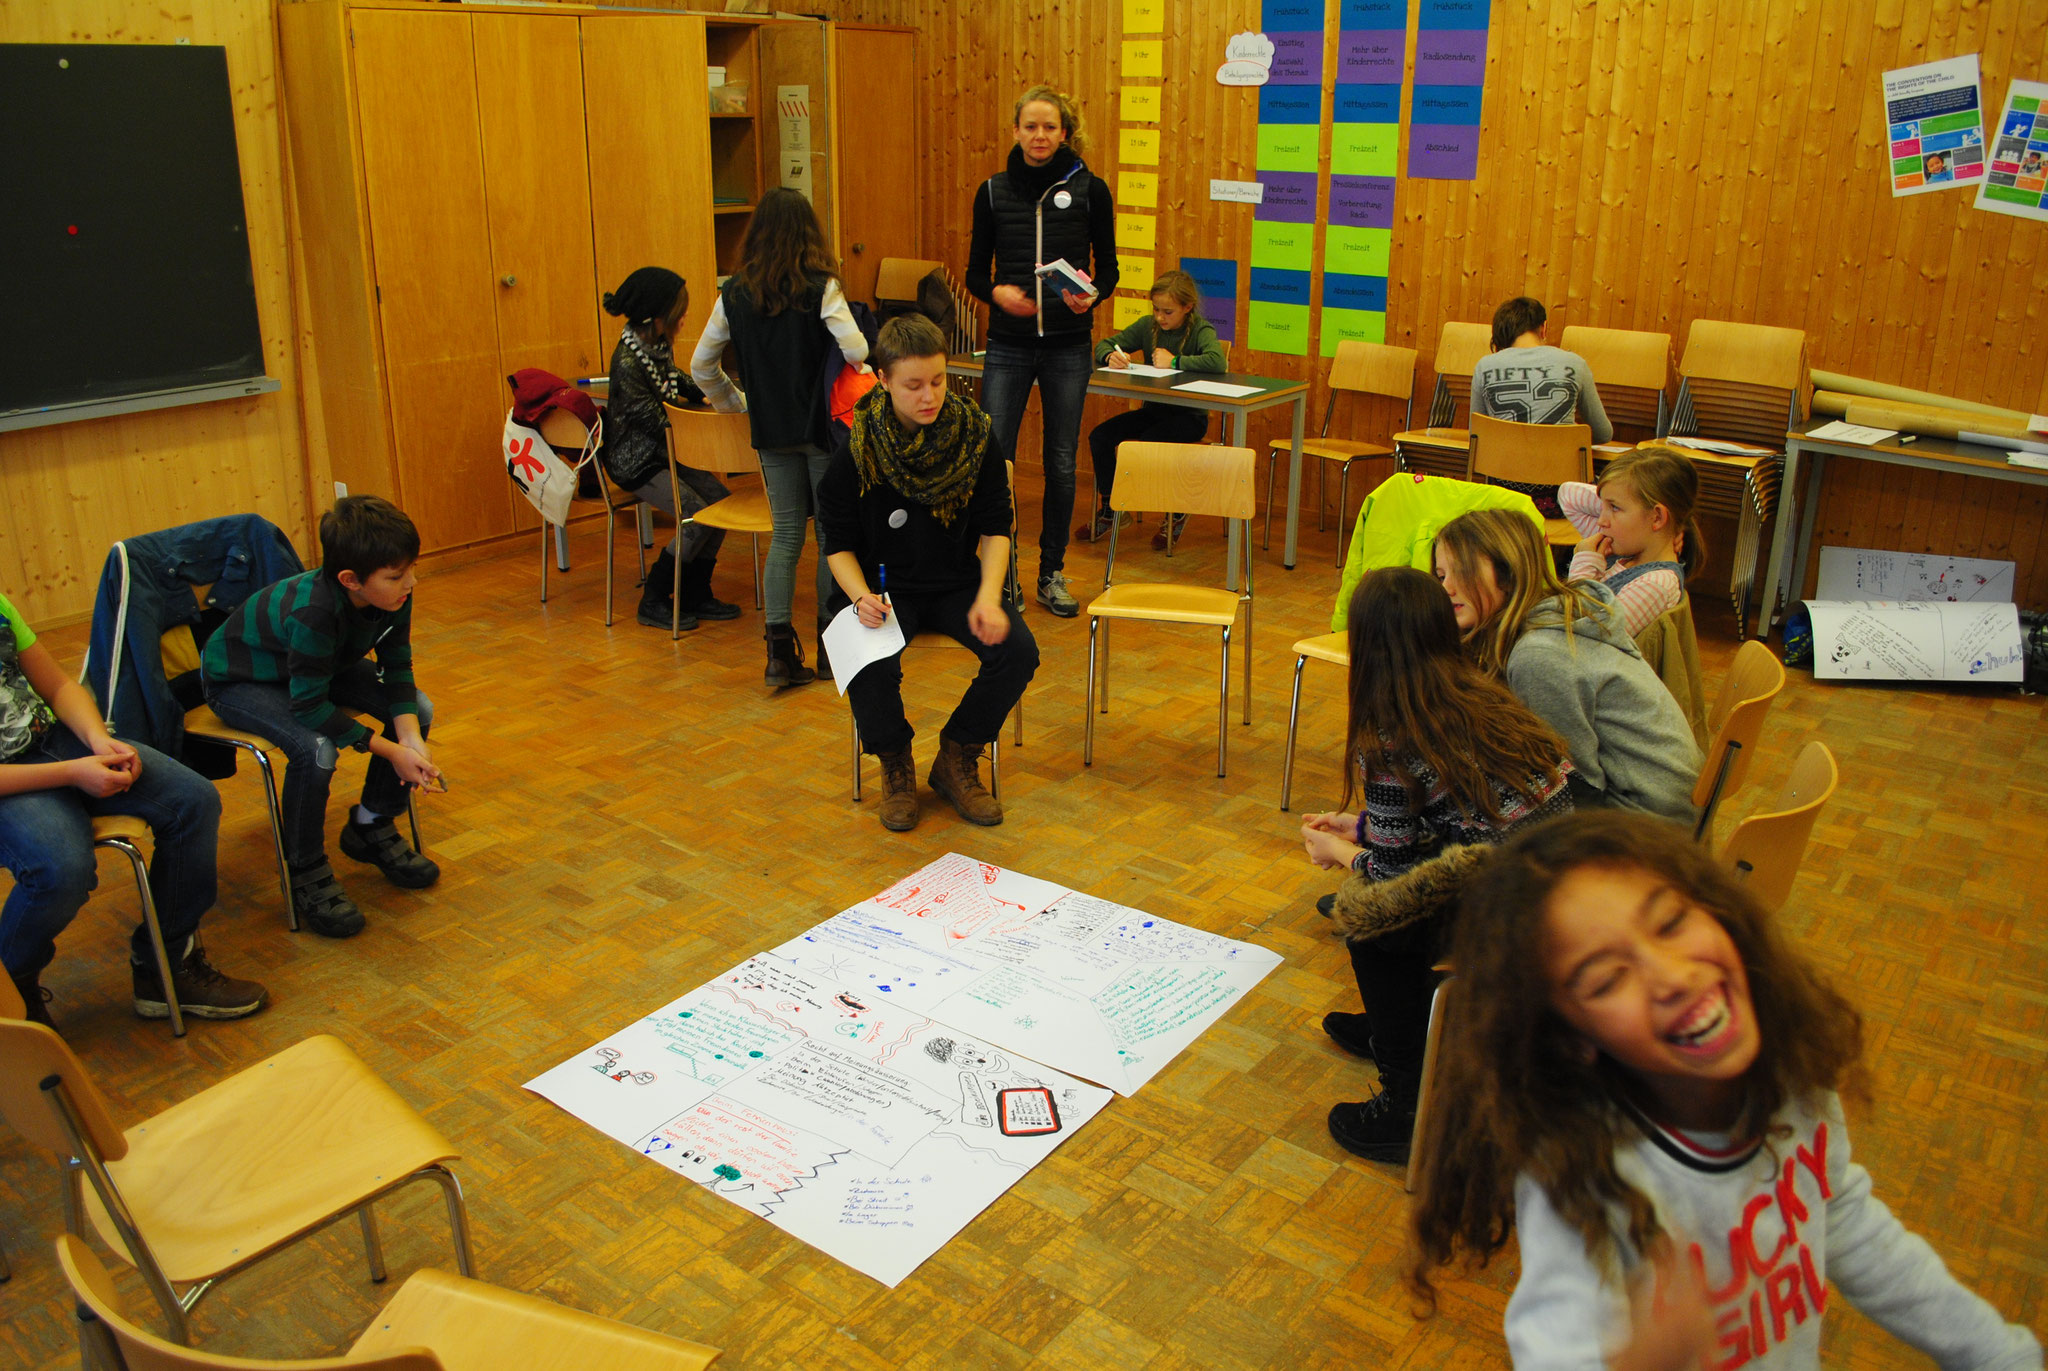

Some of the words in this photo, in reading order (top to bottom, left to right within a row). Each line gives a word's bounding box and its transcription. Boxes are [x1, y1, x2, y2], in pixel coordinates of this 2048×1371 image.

[1351, 45, 1369, 53] Mehr
[1346, 57, 1395, 66] Kinderrechte
[1423, 52, 1476, 63] Radiosendung
[1897, 75, 1932, 86] CONVENTION
[1343, 100, 1389, 110] Mittagessen
[1421, 99, 1469, 110] Mittagessen
[1273, 145, 1300, 153] Freizeit
[1349, 144, 1378, 153] Freizeit
[1424, 143, 1460, 153] Abschied
[1338, 199, 1383, 210] Vorbereitung
[1268, 238, 1294, 247] Freizeit
[1342, 243, 1370, 252] Freizeit
[1264, 321, 1291, 331] Freizeit
[1338, 328, 1366, 338] Freizeit
[1482, 366, 1553, 385] FIFTY
[1564, 366, 1577, 381] 2
[1483, 378, 1580, 425] 52
[801, 1039, 827, 1052] Recht
[828, 1048, 840, 1060] auf
[1690, 1121, 1833, 1306] UCKY
